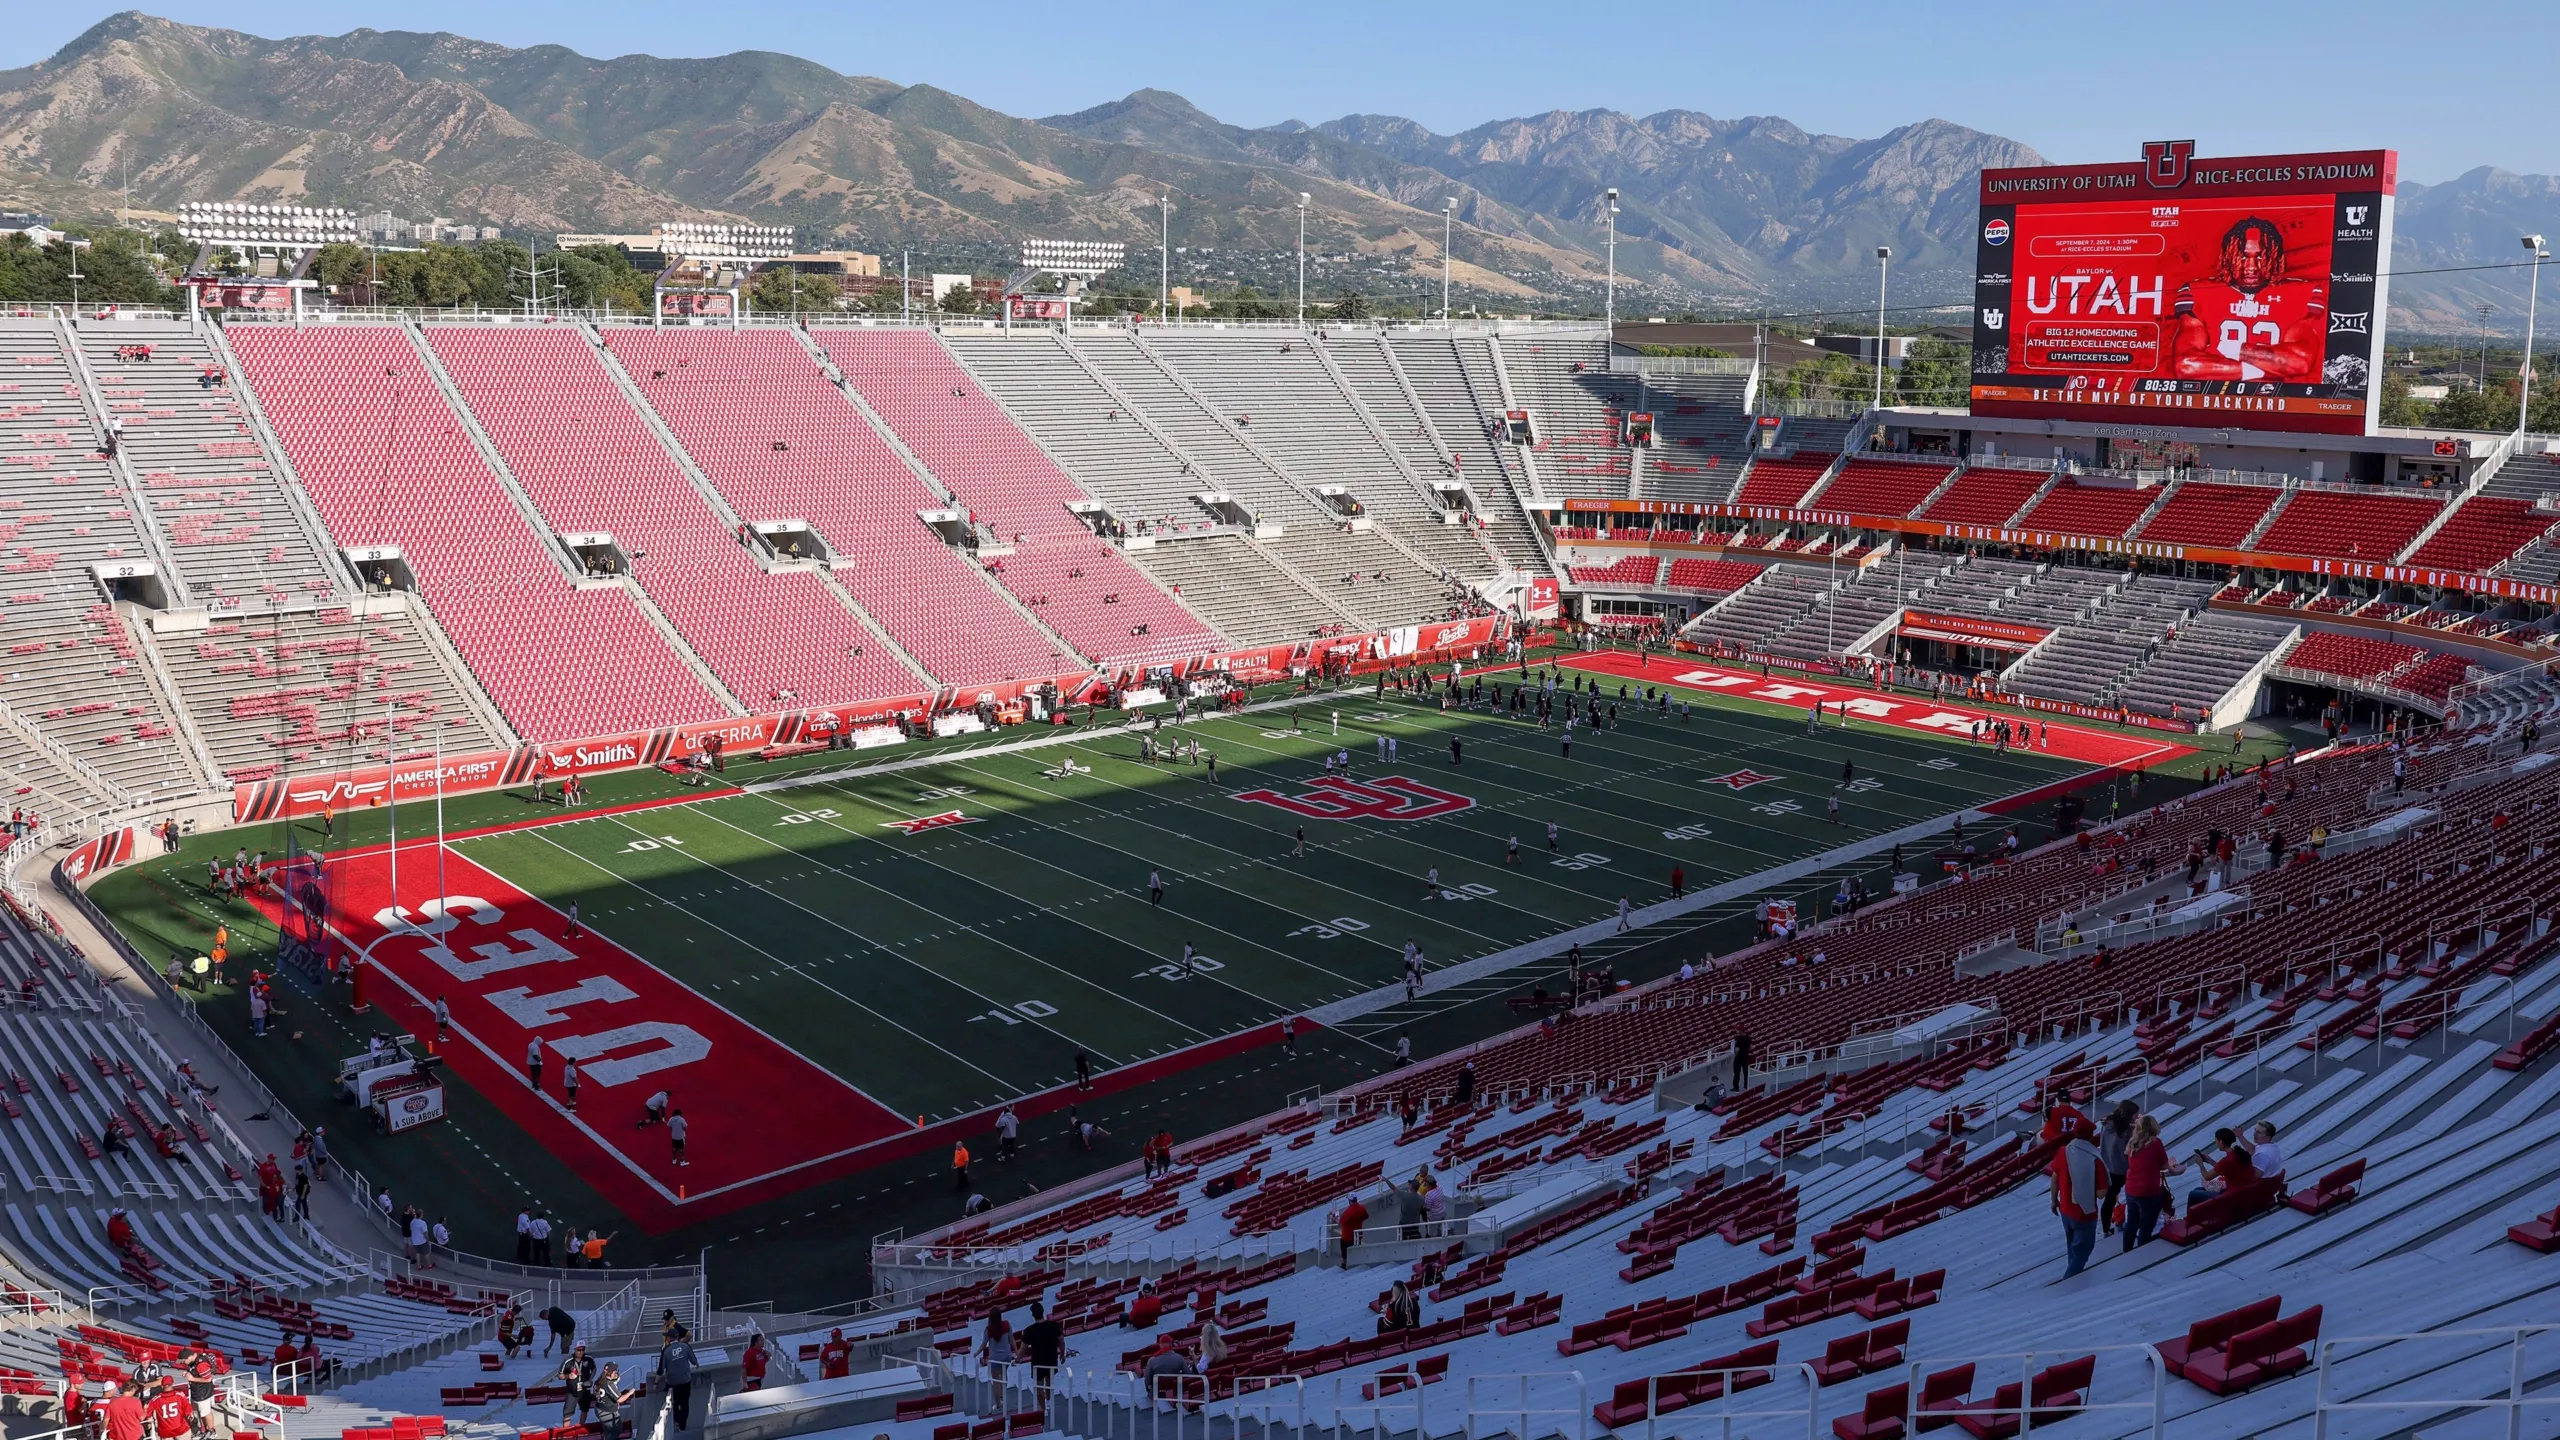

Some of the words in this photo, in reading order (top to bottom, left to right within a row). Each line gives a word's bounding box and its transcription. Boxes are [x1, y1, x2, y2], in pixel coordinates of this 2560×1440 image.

[2195, 167, 2292, 185] RICE-ECCLES
[2296, 164, 2375, 181] STADIUM
[1988, 177, 2069, 193] UNIVERSITY
[2072, 175, 2092, 190] OF
[2096, 174, 2137, 188] UTAH
[2152, 206, 2180, 216] UTAH
[1986, 228, 2008, 236] PEPSI
[2337, 229, 2373, 237] HEALTH
[2027, 276, 2164, 316] UTAH
[2046, 328, 2061, 336] BIG
[2076, 329, 2138, 337] HOMECOMING
[2071, 340, 2128, 348] EXCELLENCE
[2130, 341, 2156, 349] GAME
[2050, 353, 2129, 362] UTAHTICKETS.COM
[2097, 378, 2106, 389] 0
[2144, 380, 2178, 392] 80:36
[2236, 383, 2246, 394] 0
[2034, 389, 2048, 400] BE
[2058, 390, 2082, 402] THE
[2092, 392, 2120, 404] MVP
[2130, 393, 2146, 404] OF
[2156, 394, 2192, 407] YOUR
[2203, 395, 2285, 410] BACKYARD
[2094, 426, 2111, 434] Ken
[2113, 427, 2135, 436] Garff
[2137, 428, 2153, 437] Red
[2156, 430, 2178, 438] Zone
[2436, 442, 2456, 454] 25
[1640, 502, 1654, 512] BE
[1663, 503, 1685, 514] THE
[1694, 504, 1718, 515] MVP
[1726, 506, 1741, 516] OF
[1750, 507, 1780, 520] YOUR
[1788, 510, 1850, 526] BACKYARD
[776, 524, 788, 532] 35
[584, 537, 596, 545] 34
[1946, 524, 1960, 537] BE
[1968, 526, 1992, 540] THE
[2000, 530, 2027, 544] MVP
[2036, 534, 2051, 546] OF
[2061, 536, 2096, 550] YOUR
[2106, 539, 2184, 559] BACKYARD
[368, 550, 382, 560] 33
[119, 566, 135, 577] 32
[2312, 559, 2330, 574] BE
[2343, 562, 2373, 578] THE
[2384, 566, 2417, 582] MVP
[2429, 572, 2447, 586] OF
[2459, 575, 2499, 594] YOUR
[1948, 633, 1992, 645] UTAH
[1231, 655, 1268, 669] HEALTH
[1672, 670, 1993, 740] UTAH
[2006, 696, 2016, 704] BE
[2040, 701, 2057, 710] MVP
[2062, 704, 2071, 713] OF
[2076, 706, 2098, 717] YOUR
[2102, 711, 2148, 725] BACYARD
[574, 743, 636, 768] Smith's
[394, 766, 456, 784] AMERICA
[458, 761, 498, 775] FIRST
[453, 774, 487, 783] UNION
[780, 809, 842, 824] 20
[1750, 801, 1802, 816] 30
[1662, 825, 1712, 841] 40
[627, 836, 684, 852] 10
[1550, 852, 1612, 872] 50
[1442, 883, 1498, 902] 40
[1302, 916, 1371, 940] 30
[1149, 956, 1226, 981] 20
[372, 895, 713, 1088] UTES
[988, 1000, 1060, 1026] 10
[395, 1120, 400, 1129] A
[402, 1116, 415, 1126] SUB
[418, 1108, 440, 1121] ABOVE
[2061, 1116, 2078, 1132] 17
[161, 1402, 178, 1419] 15
